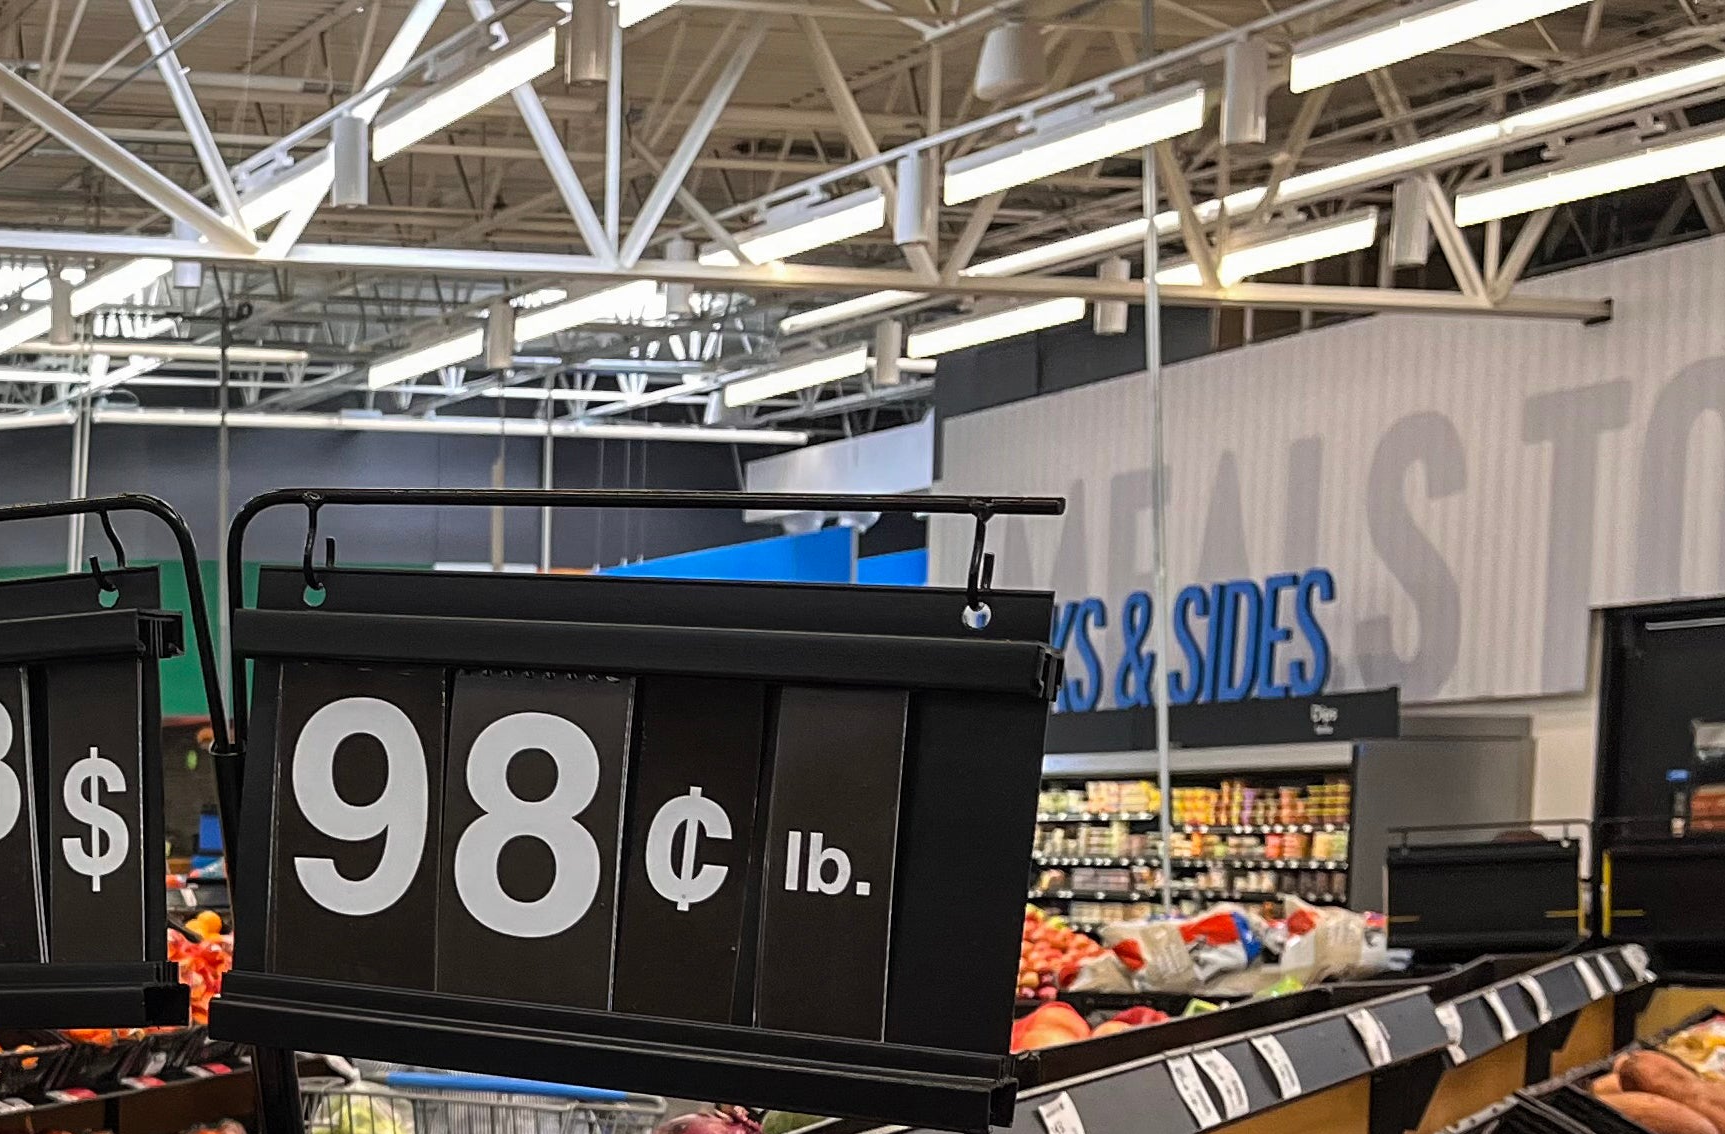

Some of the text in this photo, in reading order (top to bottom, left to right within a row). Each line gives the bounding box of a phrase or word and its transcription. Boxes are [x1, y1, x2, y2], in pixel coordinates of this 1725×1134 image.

[1115, 590, 1153, 708] &
[1167, 566, 1335, 702] SIDES
[61, 745, 129, 893] $
[291, 696, 602, 938] 98
[783, 830, 871, 896] lb.
